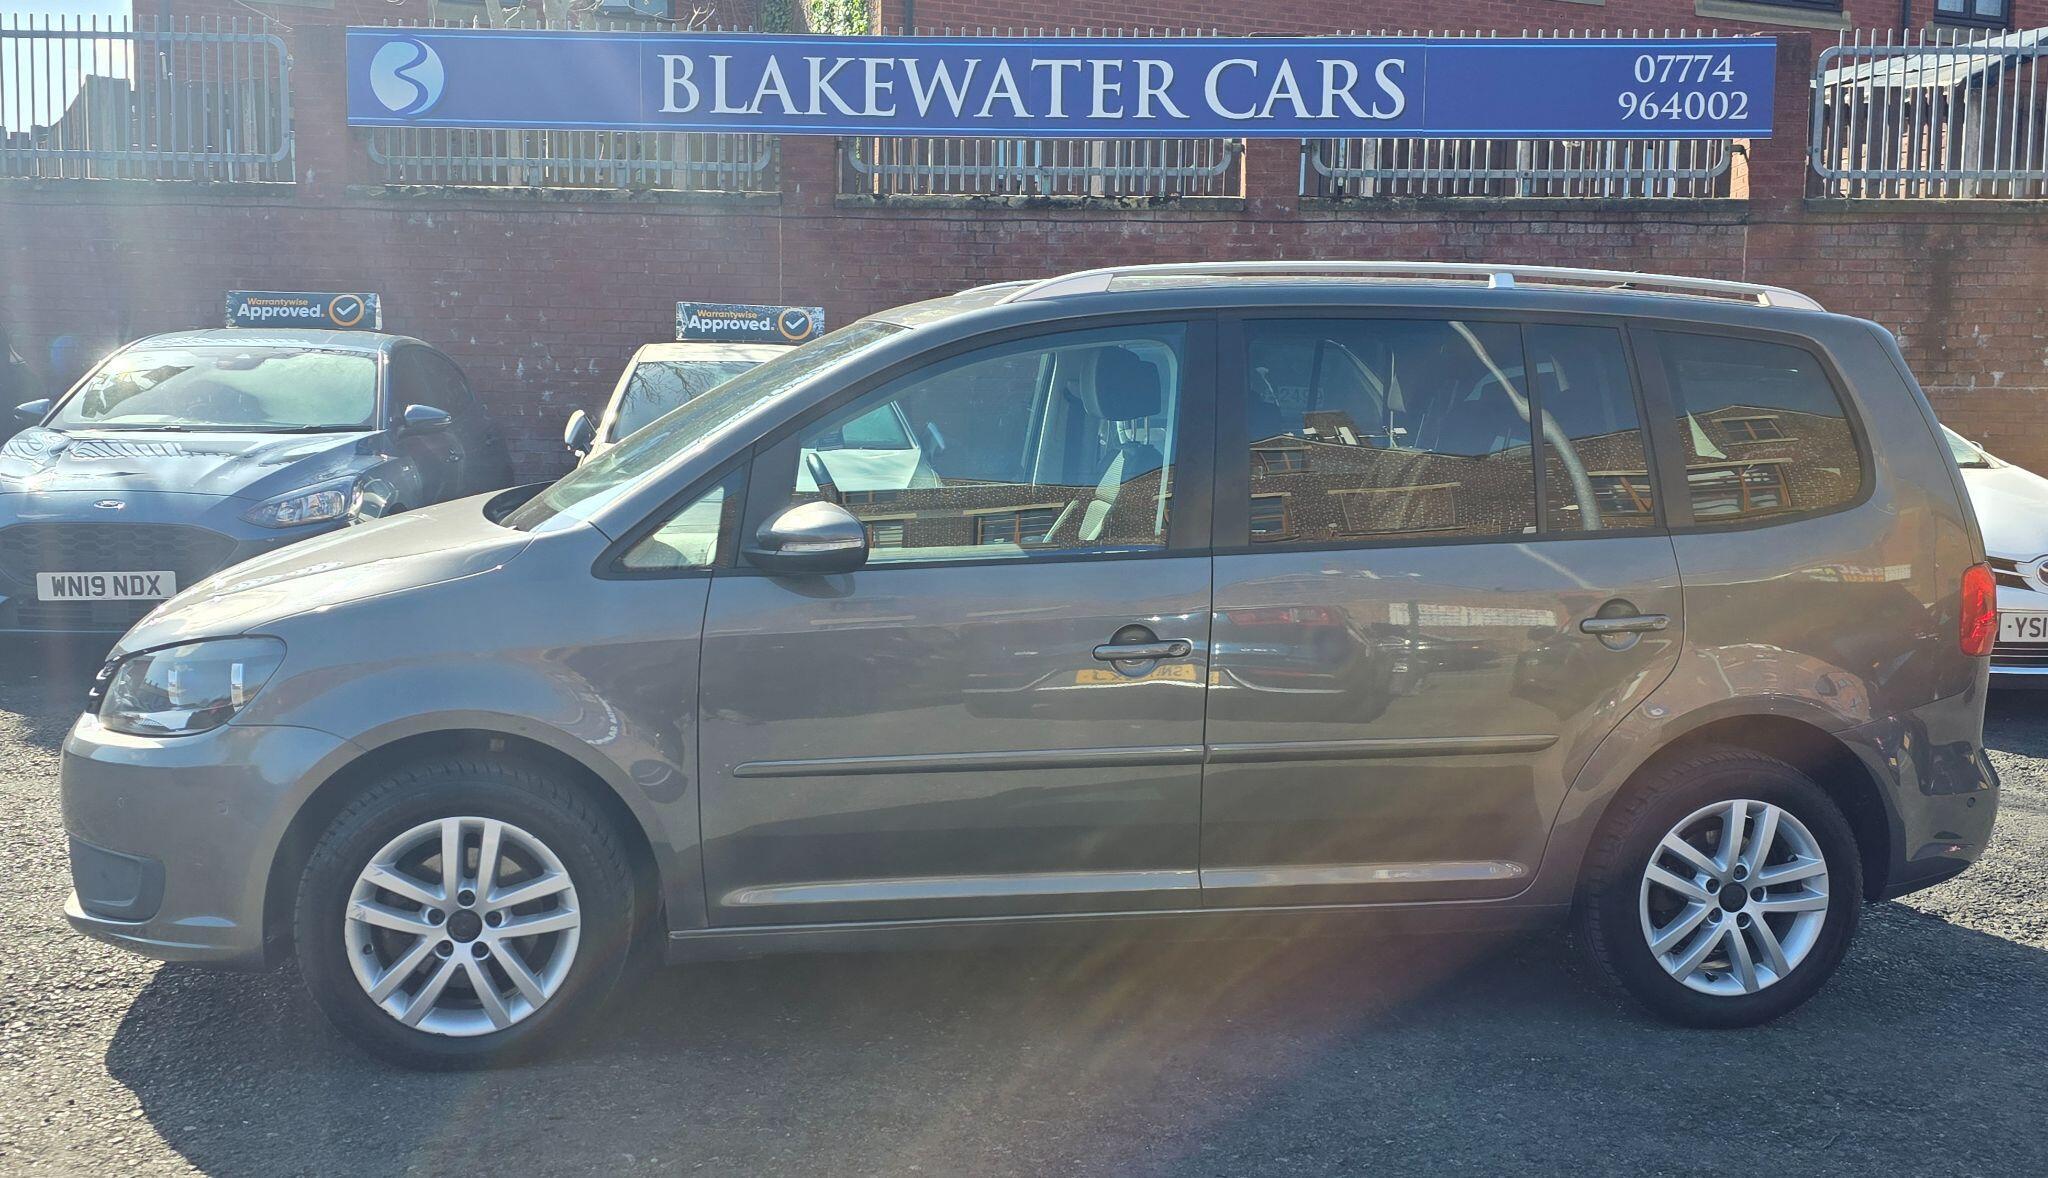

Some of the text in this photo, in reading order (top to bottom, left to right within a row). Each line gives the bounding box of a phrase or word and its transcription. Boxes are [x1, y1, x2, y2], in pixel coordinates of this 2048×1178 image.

[1634, 54, 1735, 83] 07774
[657, 54, 1405, 119] BLAKEWATER CARS
[1618, 91, 1748, 120] 964002
[247, 297, 309, 307] Warrantywise
[696, 309, 758, 319] Warrantywise
[51, 574, 161, 597] WN19 NDX
